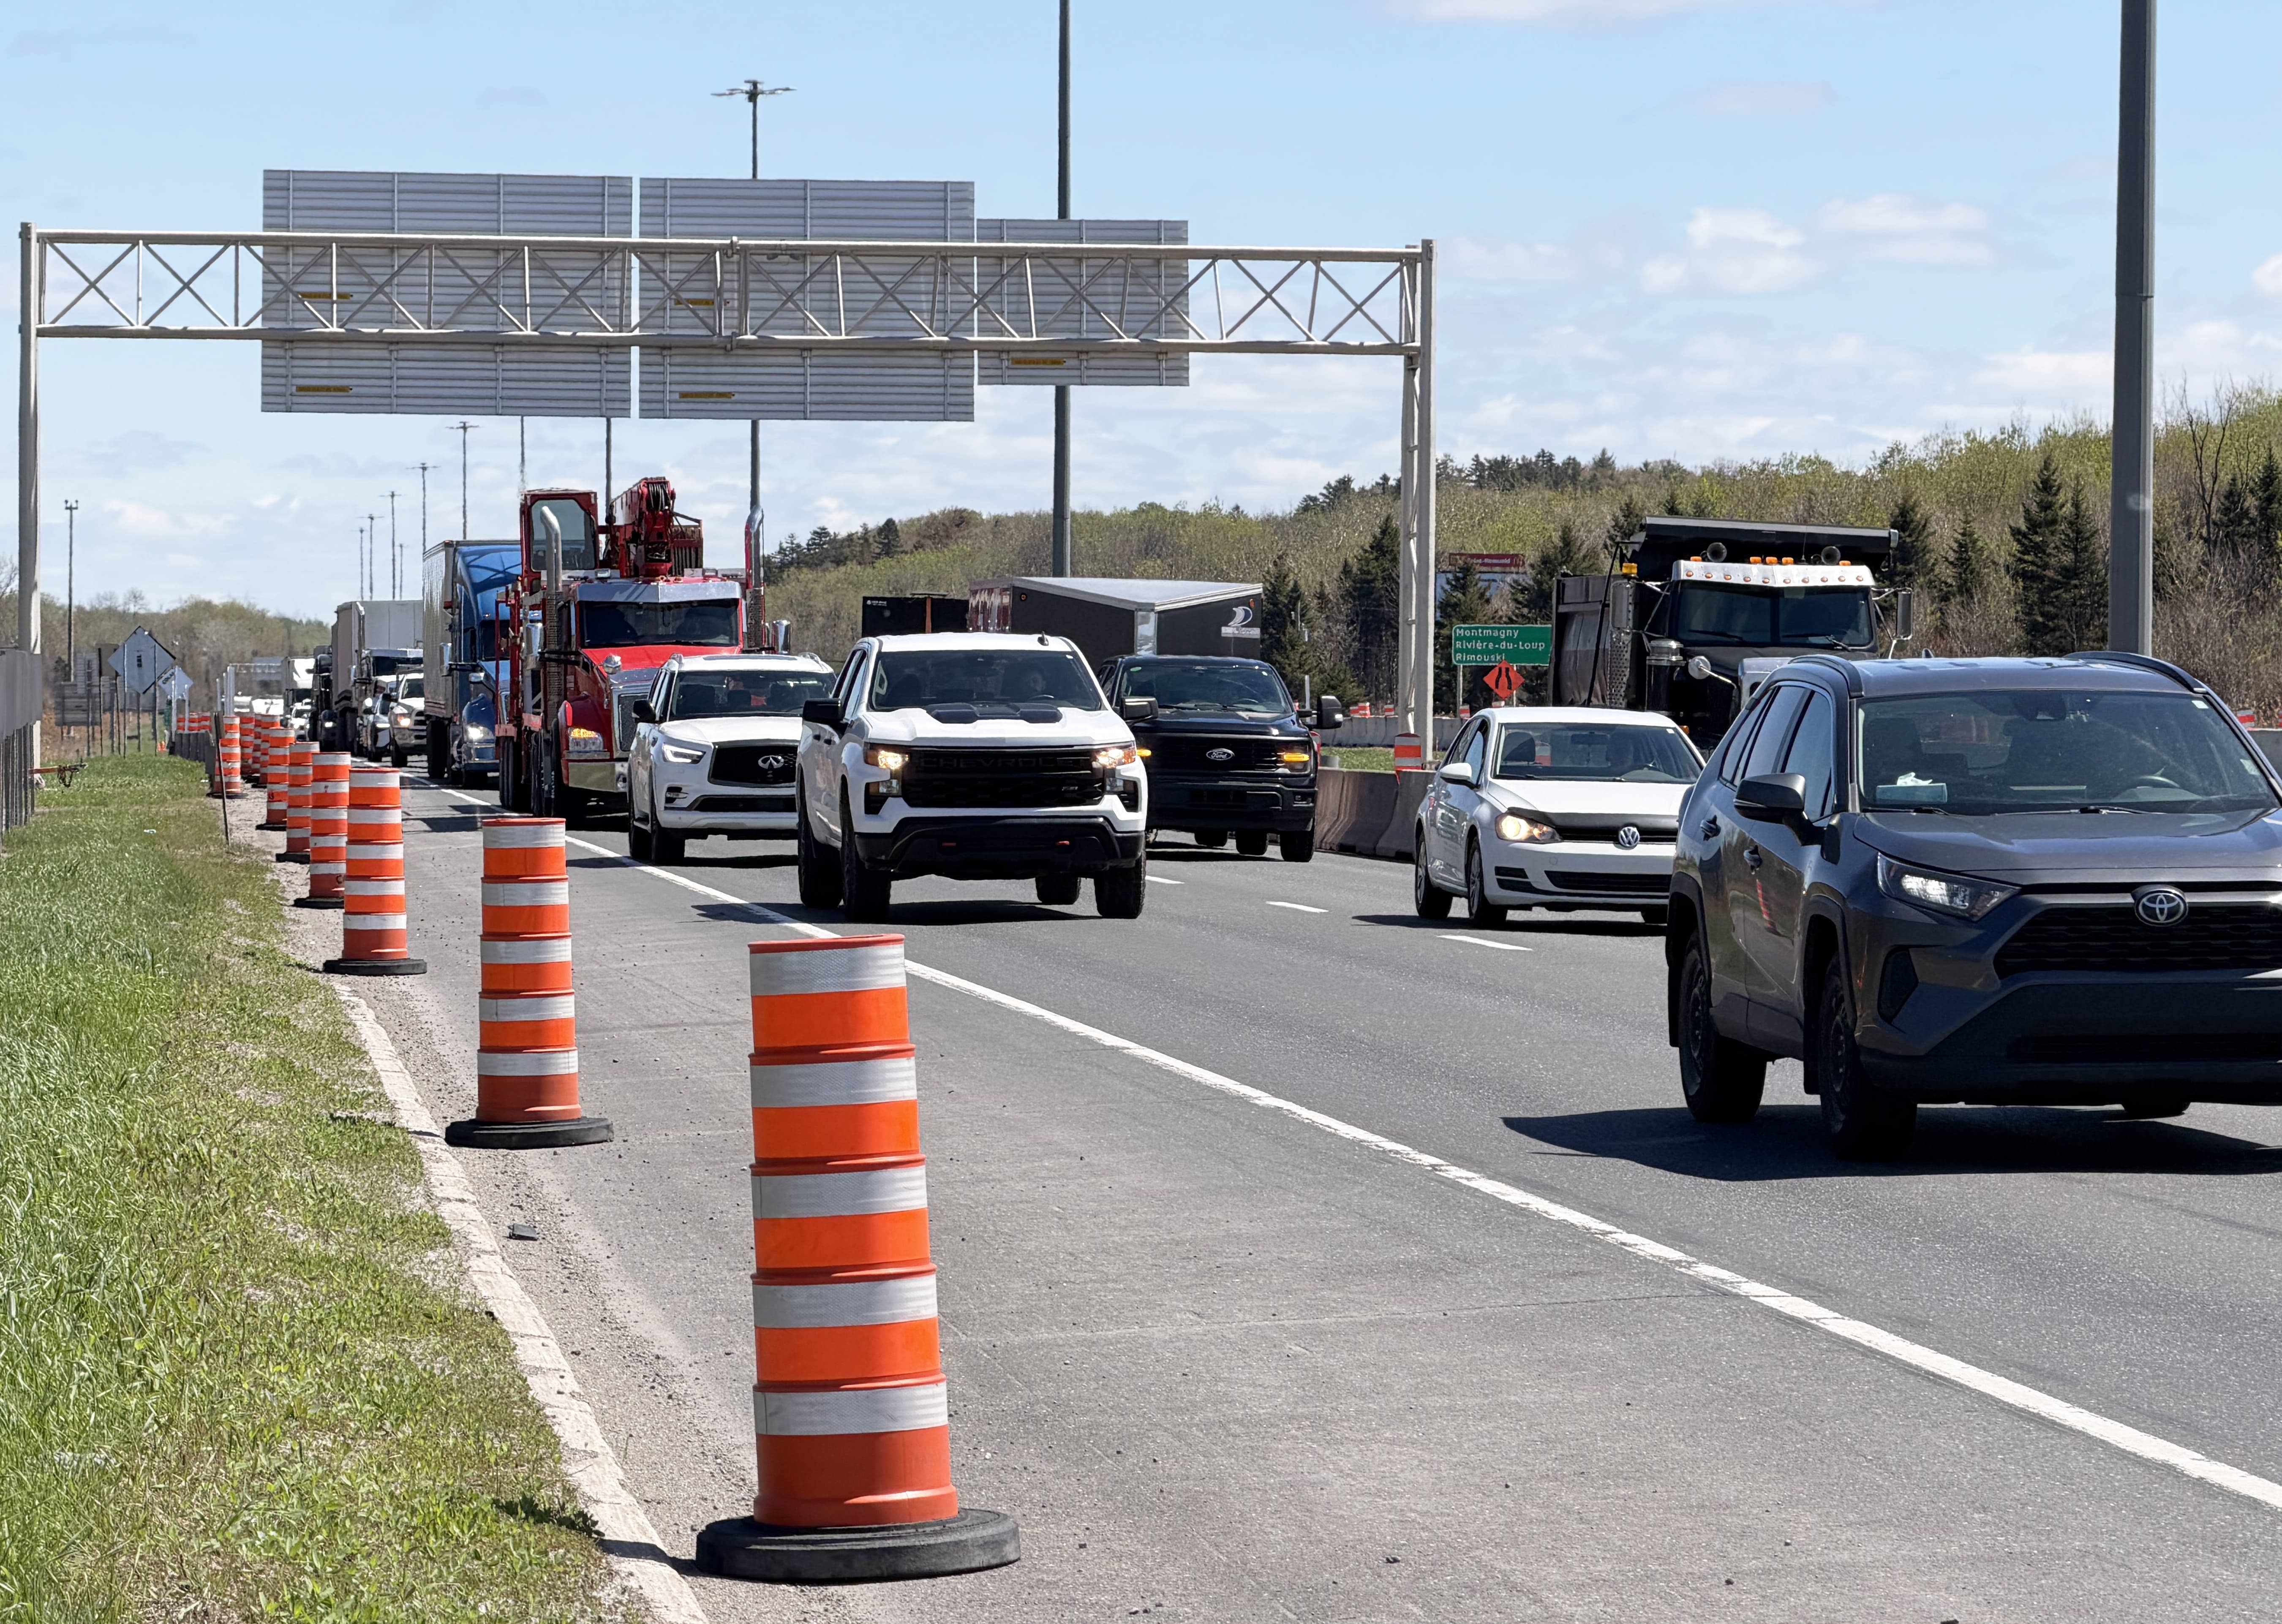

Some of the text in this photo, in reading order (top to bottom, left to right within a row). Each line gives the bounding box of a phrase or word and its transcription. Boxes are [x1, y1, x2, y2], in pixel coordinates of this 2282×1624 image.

[1456, 628, 1519, 638] Montmagny
[1456, 640, 1545, 651] Rivière-du-Loup
[1456, 653, 1505, 661] Rimouski
